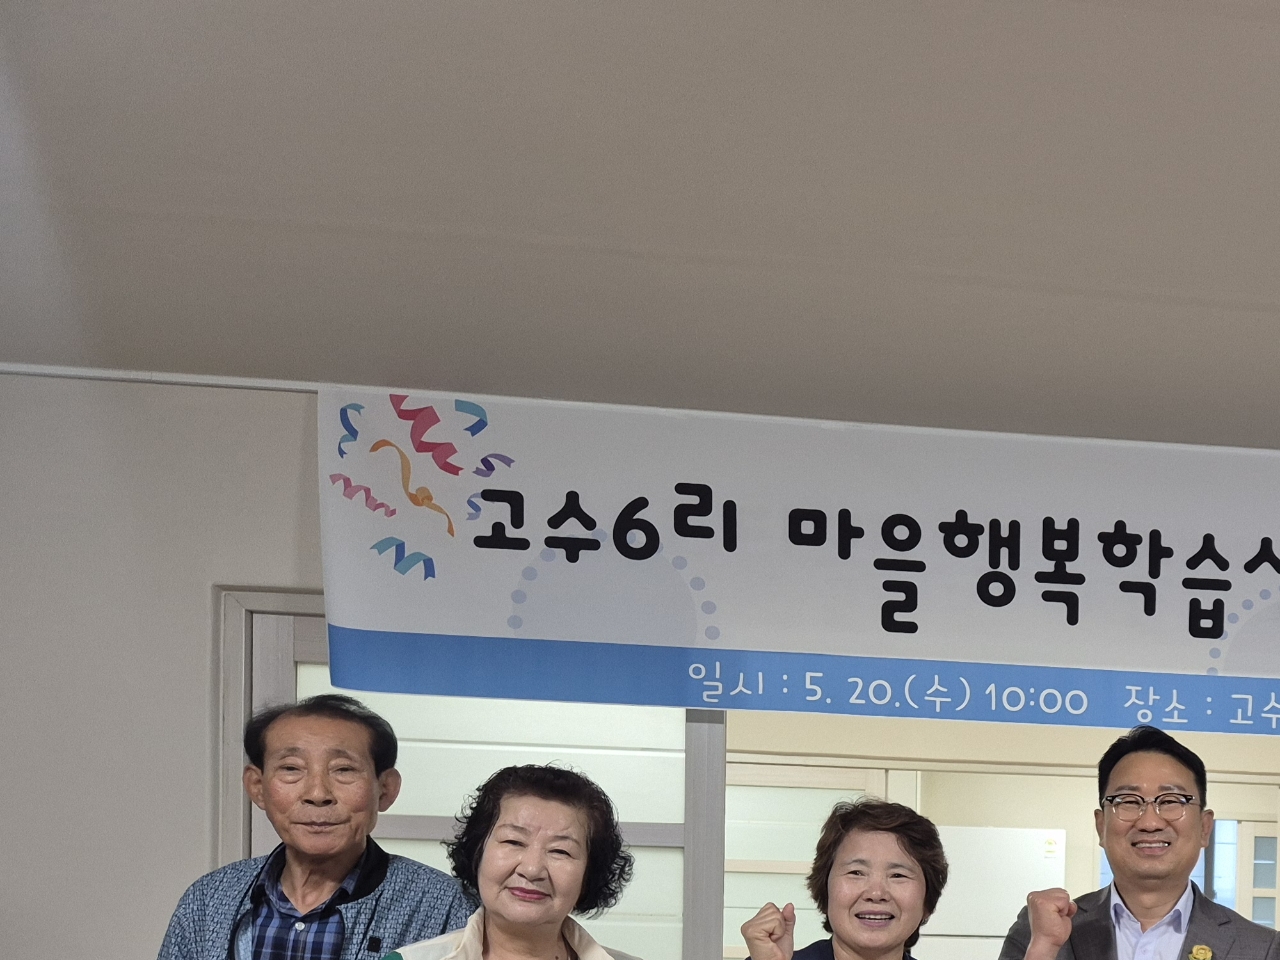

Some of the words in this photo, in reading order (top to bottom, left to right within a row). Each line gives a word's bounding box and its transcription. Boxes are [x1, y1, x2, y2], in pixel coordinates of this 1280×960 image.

[473, 482, 738, 564] 고수6리
[804, 671, 833, 705] 5.
[984, 683, 1089, 716] 10:00
